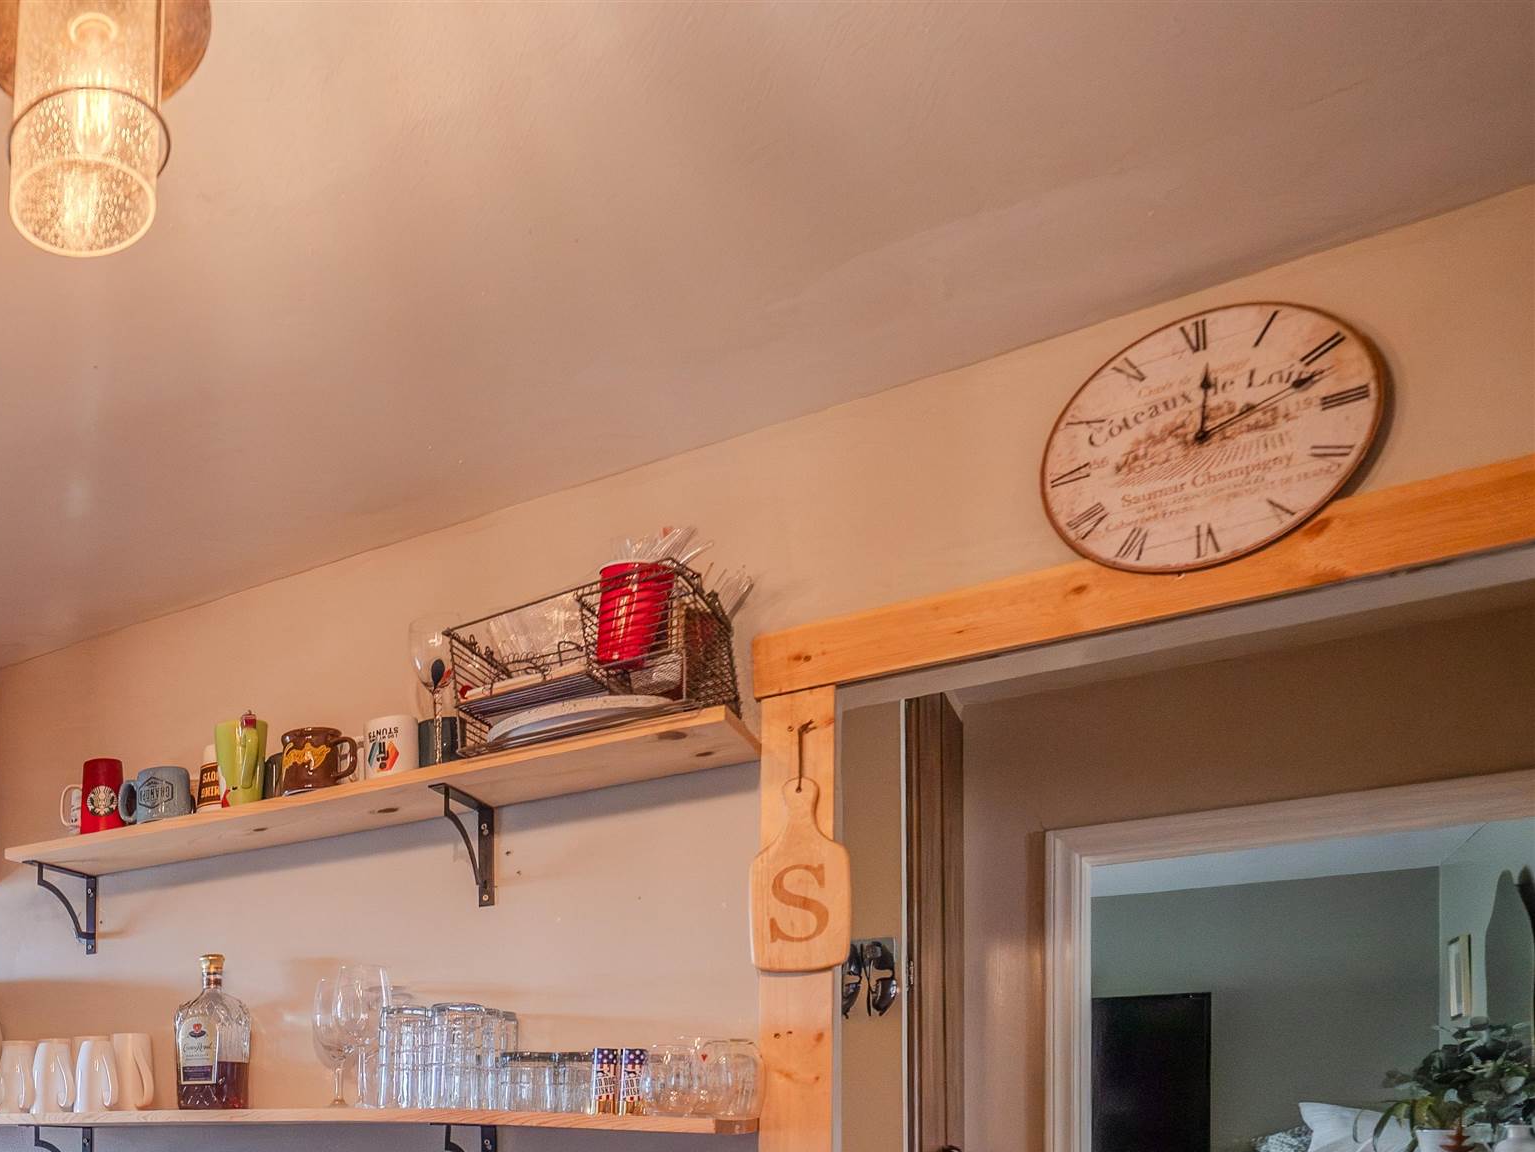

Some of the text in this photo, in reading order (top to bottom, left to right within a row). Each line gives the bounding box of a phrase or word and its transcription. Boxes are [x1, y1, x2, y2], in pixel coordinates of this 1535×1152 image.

[1319, 382, 1371, 413] III
[368, 726, 399, 739] STUNTS
[770, 863, 829, 944] S
